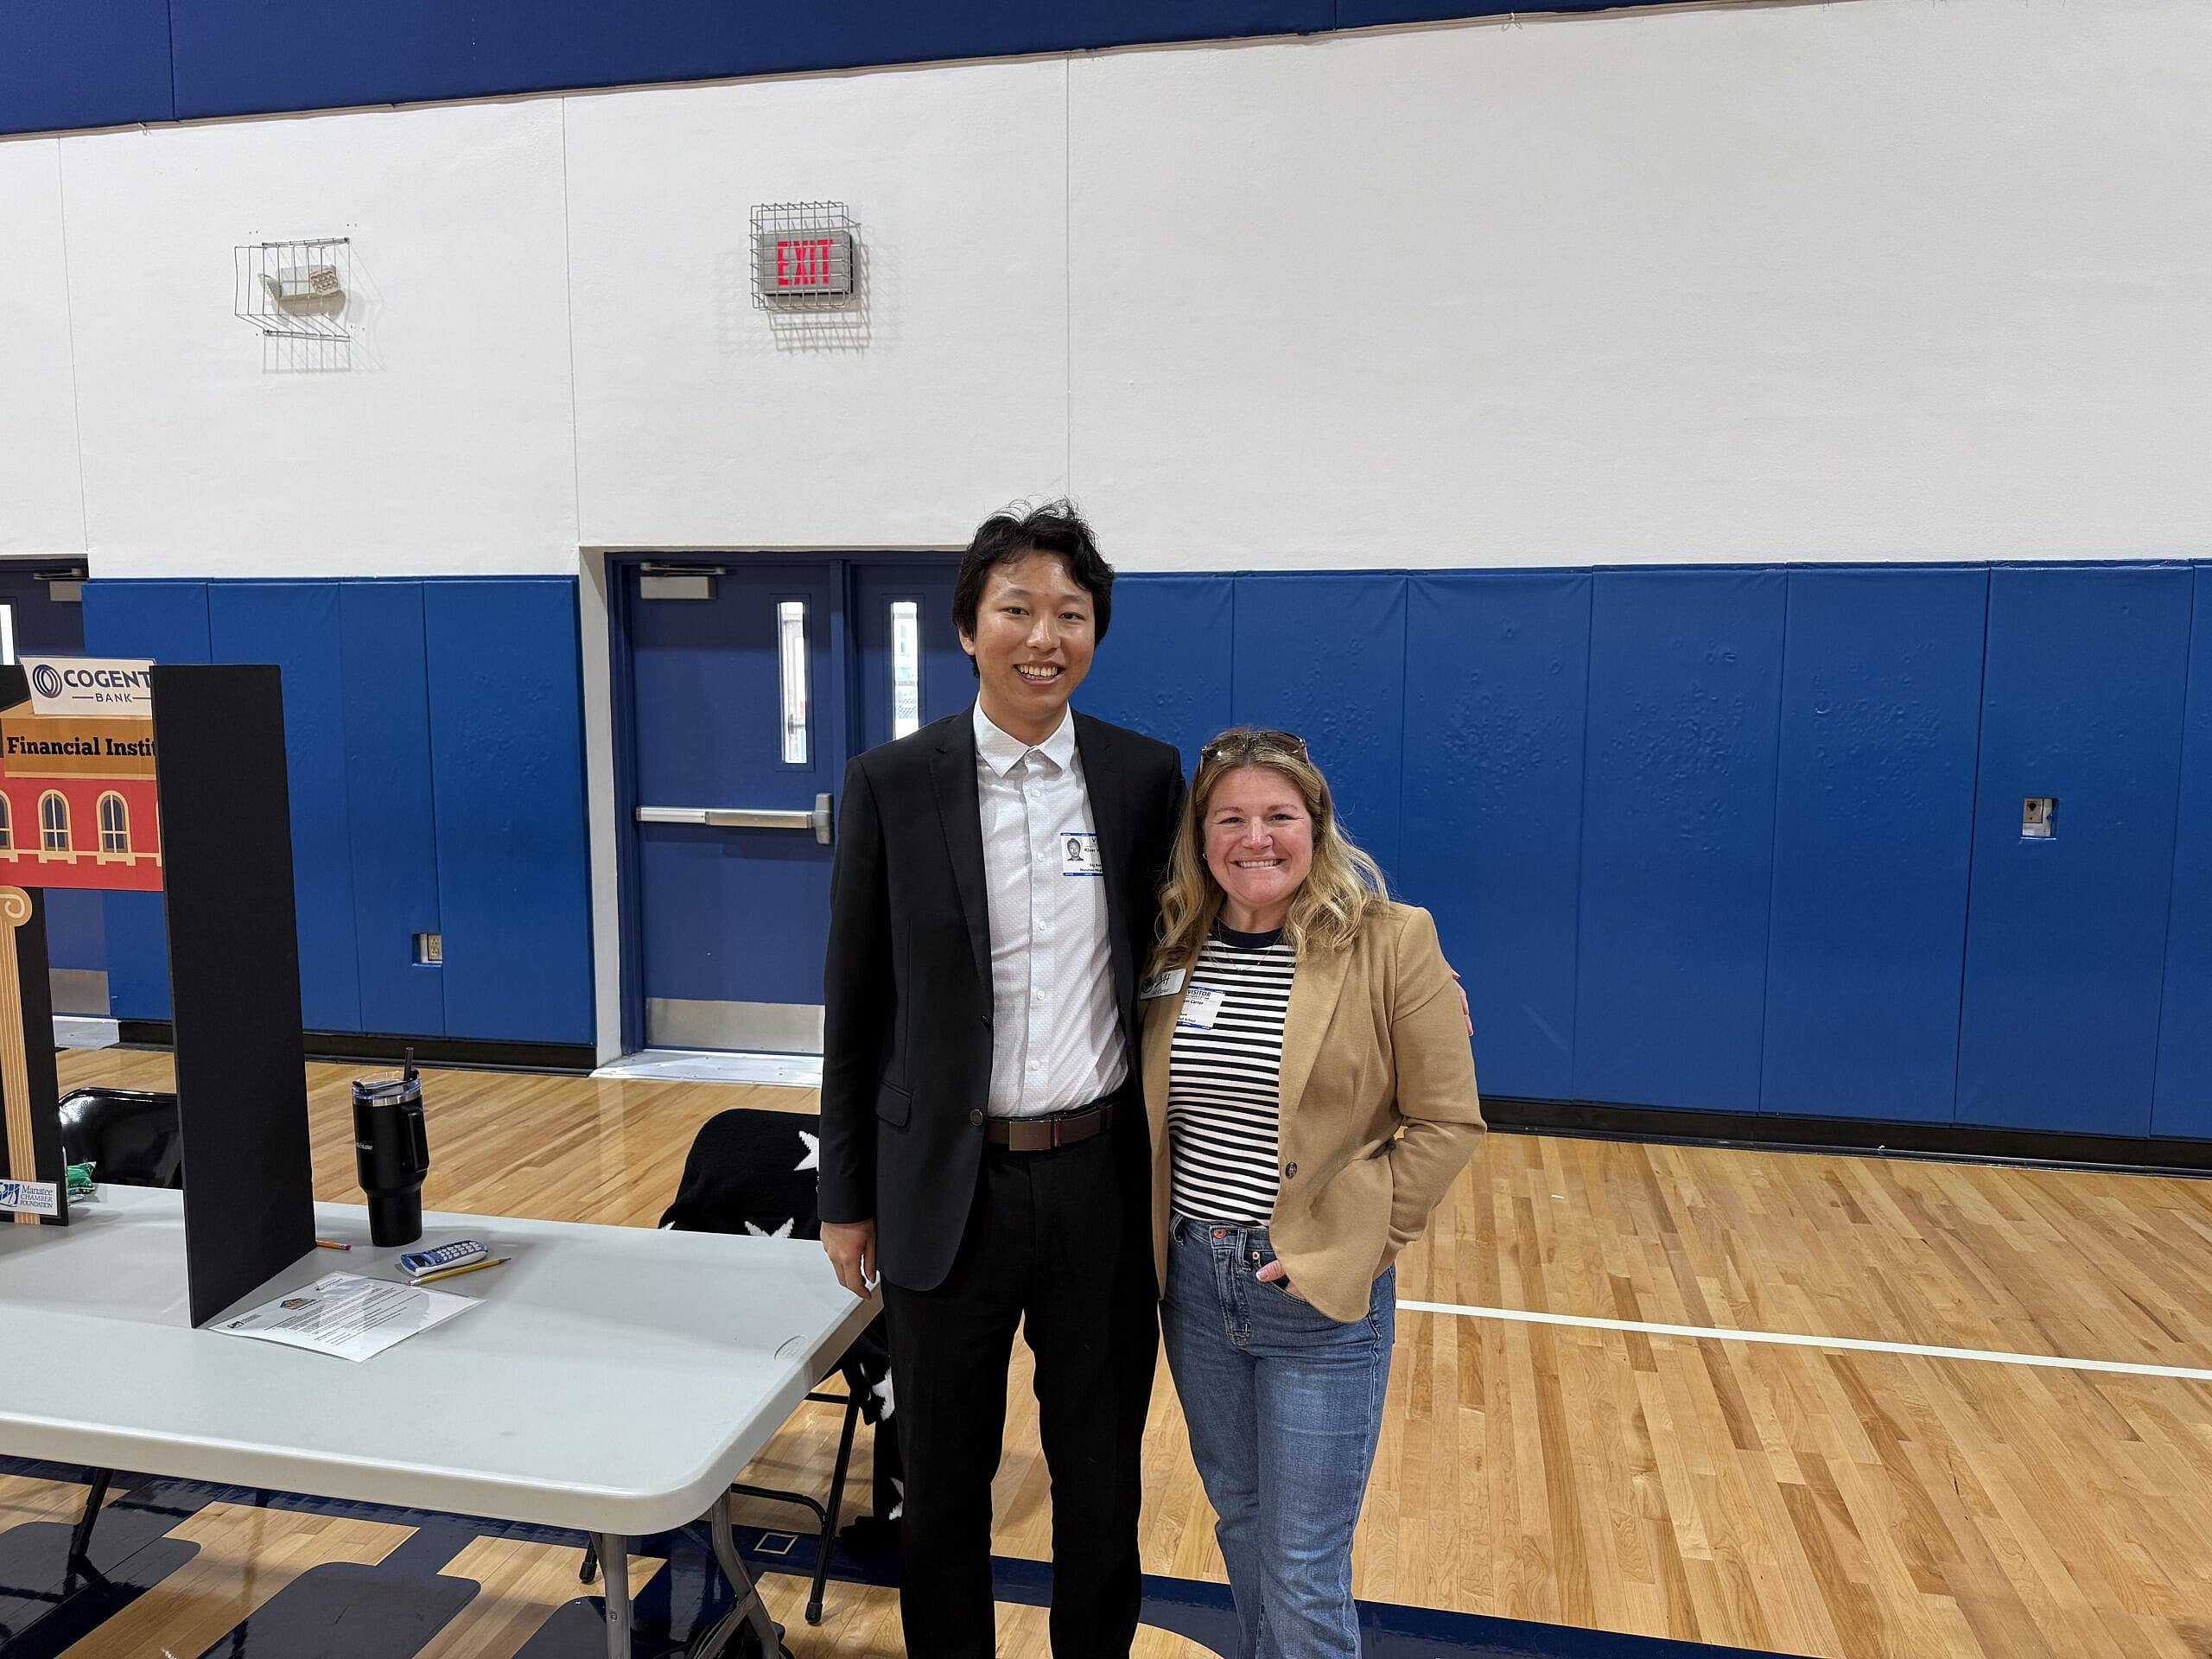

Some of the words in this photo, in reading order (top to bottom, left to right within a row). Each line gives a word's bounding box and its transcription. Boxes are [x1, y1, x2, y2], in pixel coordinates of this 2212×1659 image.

[778, 239, 834, 285] EXIT
[63, 670, 150, 689] COGENT
[96, 693, 132, 702] BANK
[7, 736, 100, 756] Financial
[20, 1193, 53, 1202] CHAMBER
[22, 1185, 54, 1196] Manatee
